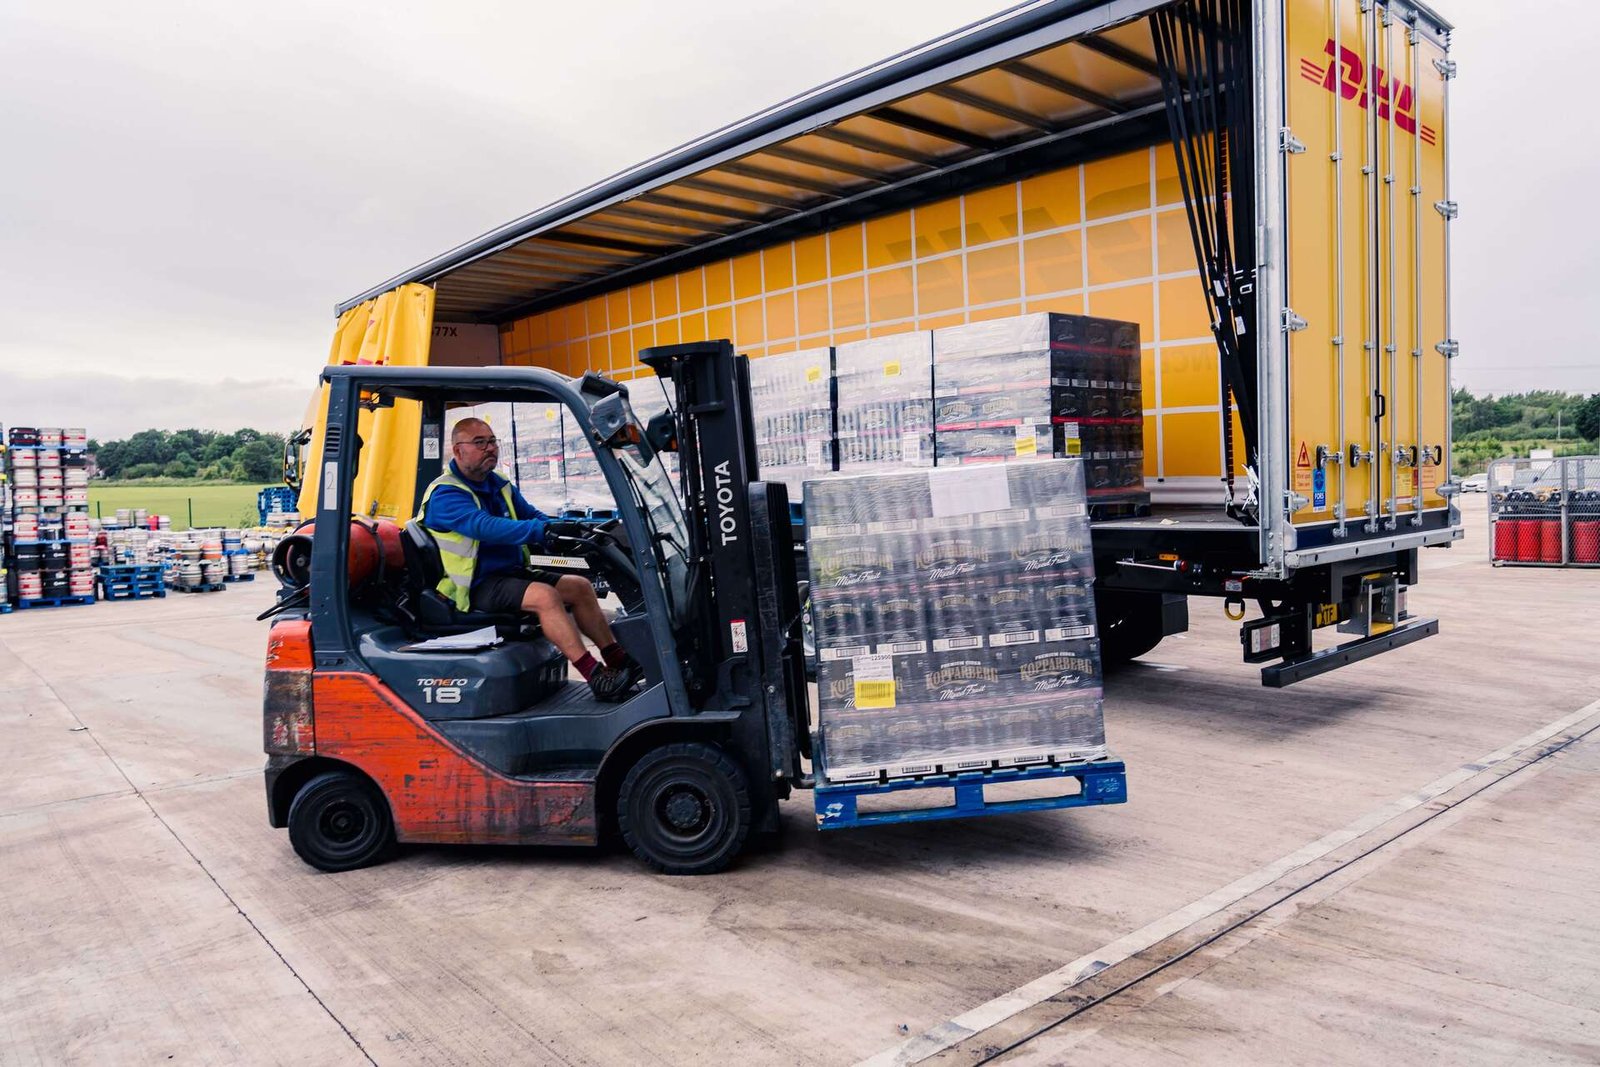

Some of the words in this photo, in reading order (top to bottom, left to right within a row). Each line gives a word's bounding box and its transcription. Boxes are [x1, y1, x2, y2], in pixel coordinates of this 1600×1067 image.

[1322, 38, 1416, 136] DHL
[432, 326, 458, 337] 77X
[326, 471, 336, 490] 2
[714, 460, 738, 546] TOYOTA
[926, 665, 999, 690] KOPPARBERG
[1020, 657, 1093, 682] KOPPARBERG
[940, 686, 967, 700] Mixed
[965, 683, 986, 696] Fruit
[1034, 679, 1061, 692] Mixed
[1059, 674, 1080, 687] Fruit
[422, 686, 462, 704] 18
